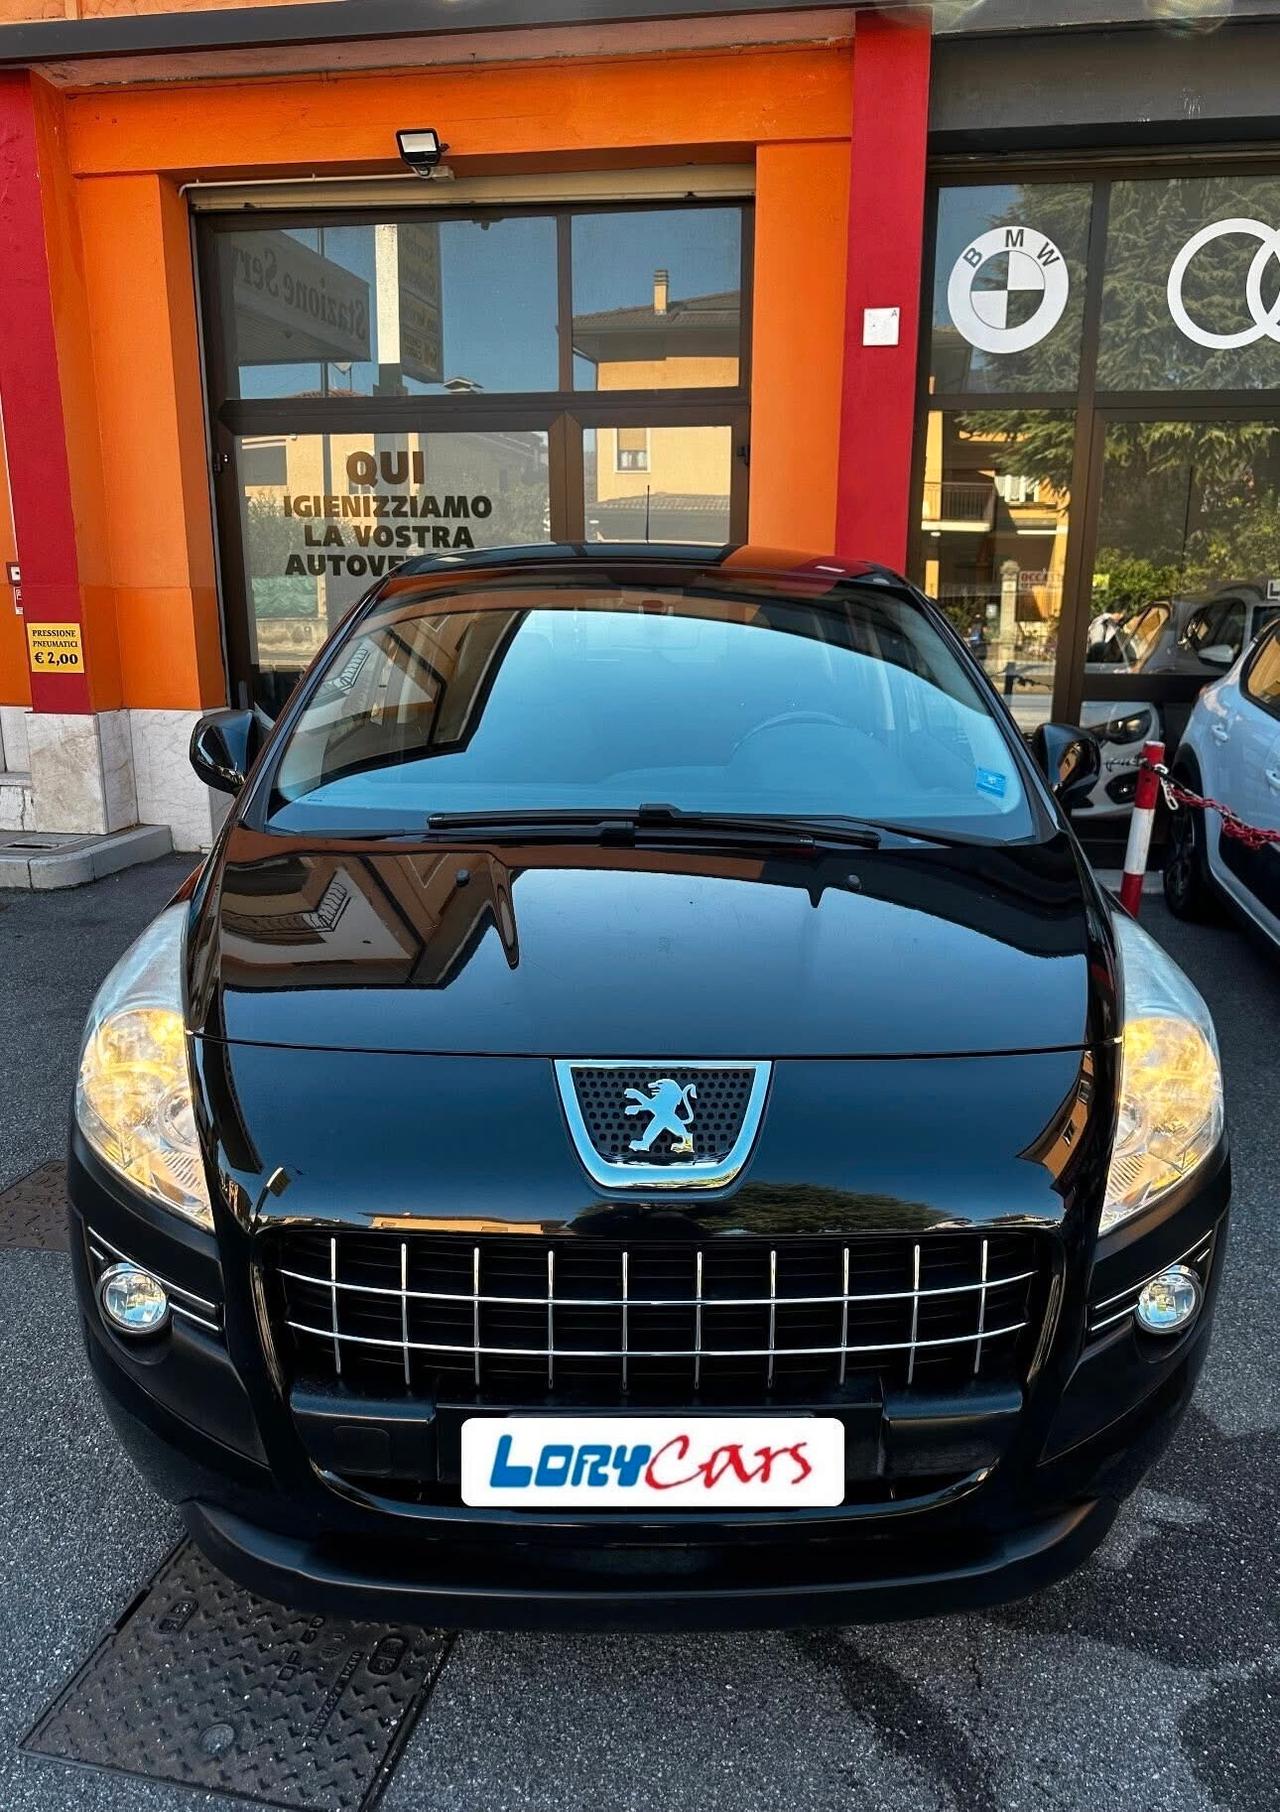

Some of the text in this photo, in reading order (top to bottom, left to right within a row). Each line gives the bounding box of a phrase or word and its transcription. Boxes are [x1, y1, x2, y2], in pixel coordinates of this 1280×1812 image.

[962, 228, 1061, 268] BMW
[346, 450, 425, 488] QUI
[283, 495, 493, 519] IGIENIZZIAMO
[304, 525, 475, 549] LA VOSTRA
[32, 629, 76, 637] PRESSIONE
[32, 640, 78, 648] PNEUMATICI
[34, 651, 78, 666] € 2,00
